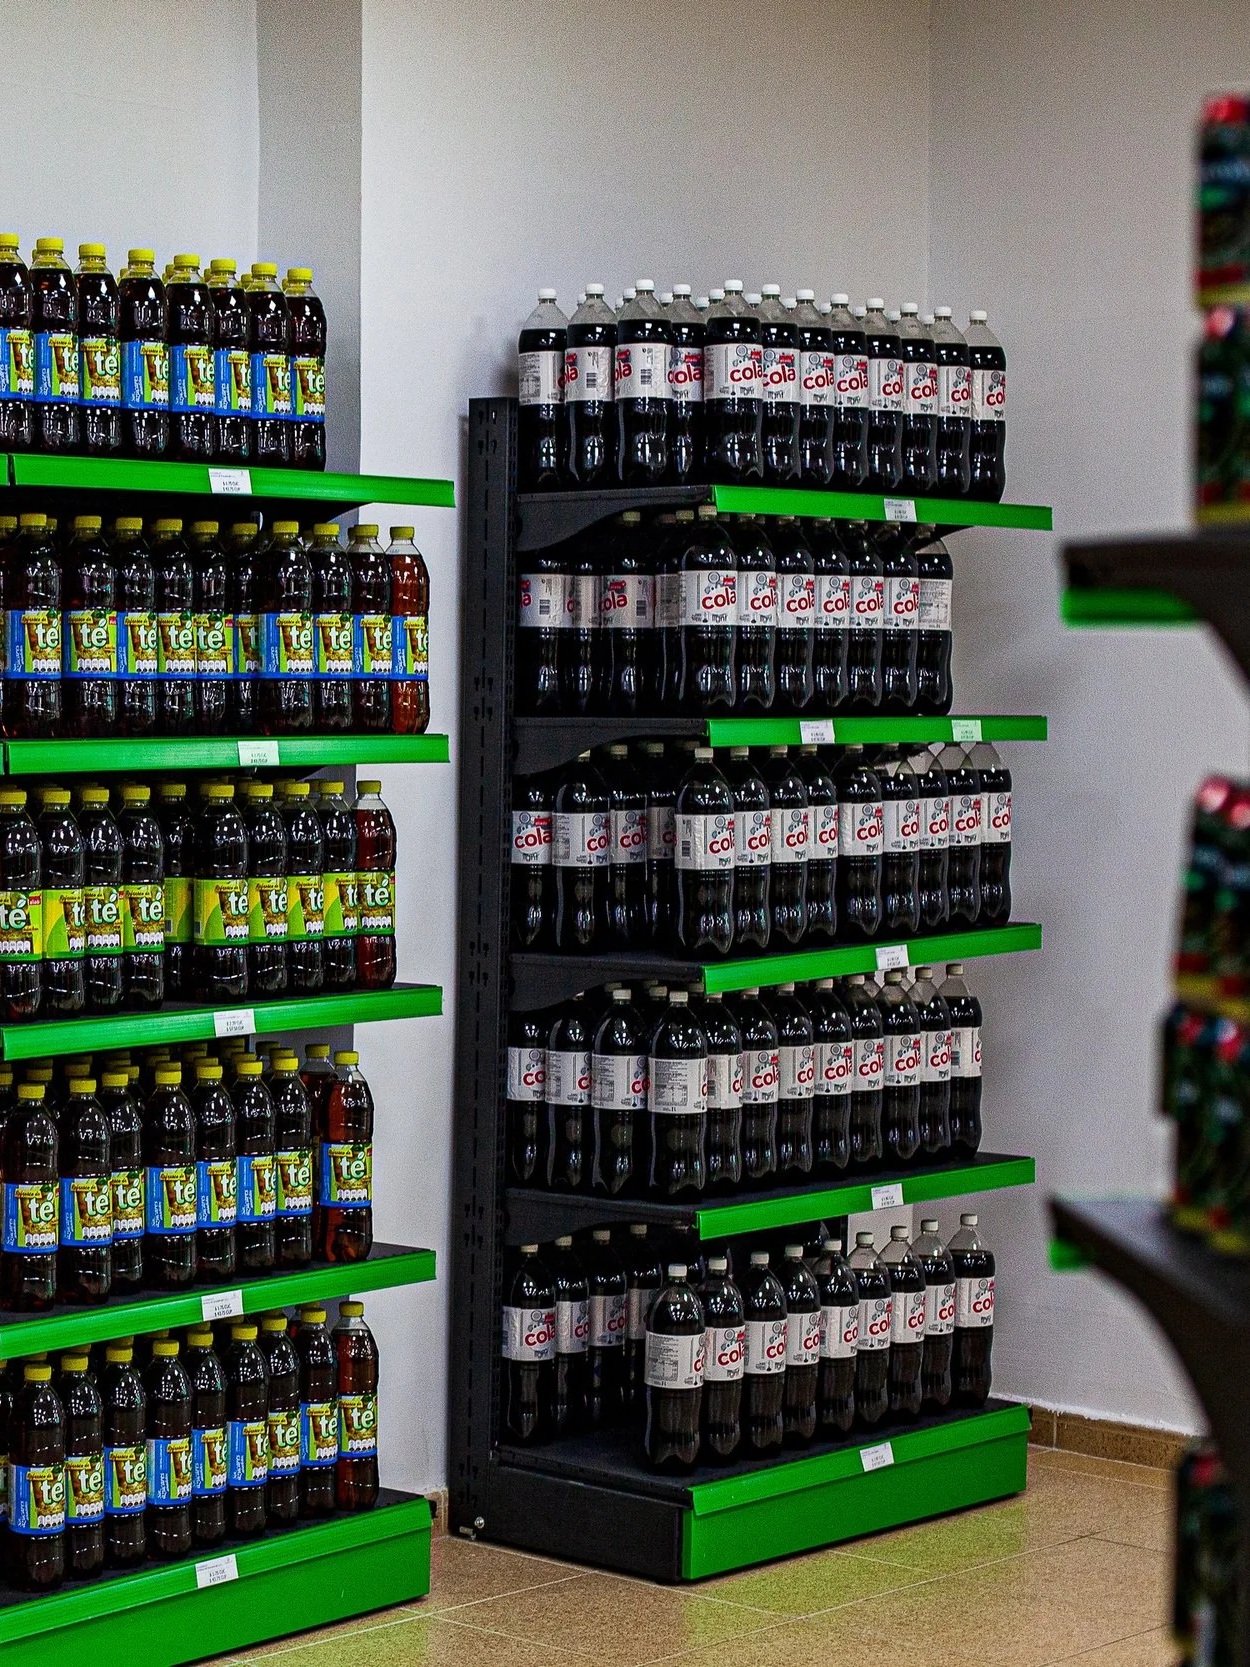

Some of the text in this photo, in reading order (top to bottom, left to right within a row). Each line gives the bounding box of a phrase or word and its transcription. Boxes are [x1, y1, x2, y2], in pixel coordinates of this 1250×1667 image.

[95, 349, 118, 375] té
[882, 377, 903, 395] col
[951, 384, 970, 402] col
[986, 387, 1005, 405] col
[702, 588, 736, 609] cola
[894, 593, 918, 614] col
[36, 619, 58, 649] té
[81, 620, 107, 648] té
[168, 620, 193, 649] té
[197, 621, 224, 649] té
[290, 620, 312, 649] té
[329, 621, 350, 649] té
[515, 828, 552, 848] cola
[587, 830, 608, 851] col
[709, 831, 734, 854] col
[748, 826, 771, 850] col
[139, 891, 163, 922] té
[365, 879, 388, 907] té
[92, 893, 117, 923] té
[523, 1071, 545, 1086] co
[797, 1066, 814, 1083] co
[288, 1158, 310, 1187] té
[340, 1152, 365, 1180] té
[85, 1185, 109, 1216] té
[116, 1180, 140, 1208] té
[174, 1175, 194, 1204] té
[29, 1192, 54, 1223] té
[908, 1312, 924, 1328] co
[939, 1304, 954, 1320] co
[804, 1332, 820, 1349] co
[351, 1402, 374, 1430] té
[275, 1418, 297, 1447] té
[79, 1462, 102, 1493] té
[124, 1454, 145, 1484] té
[41, 1473, 64, 1504] té
